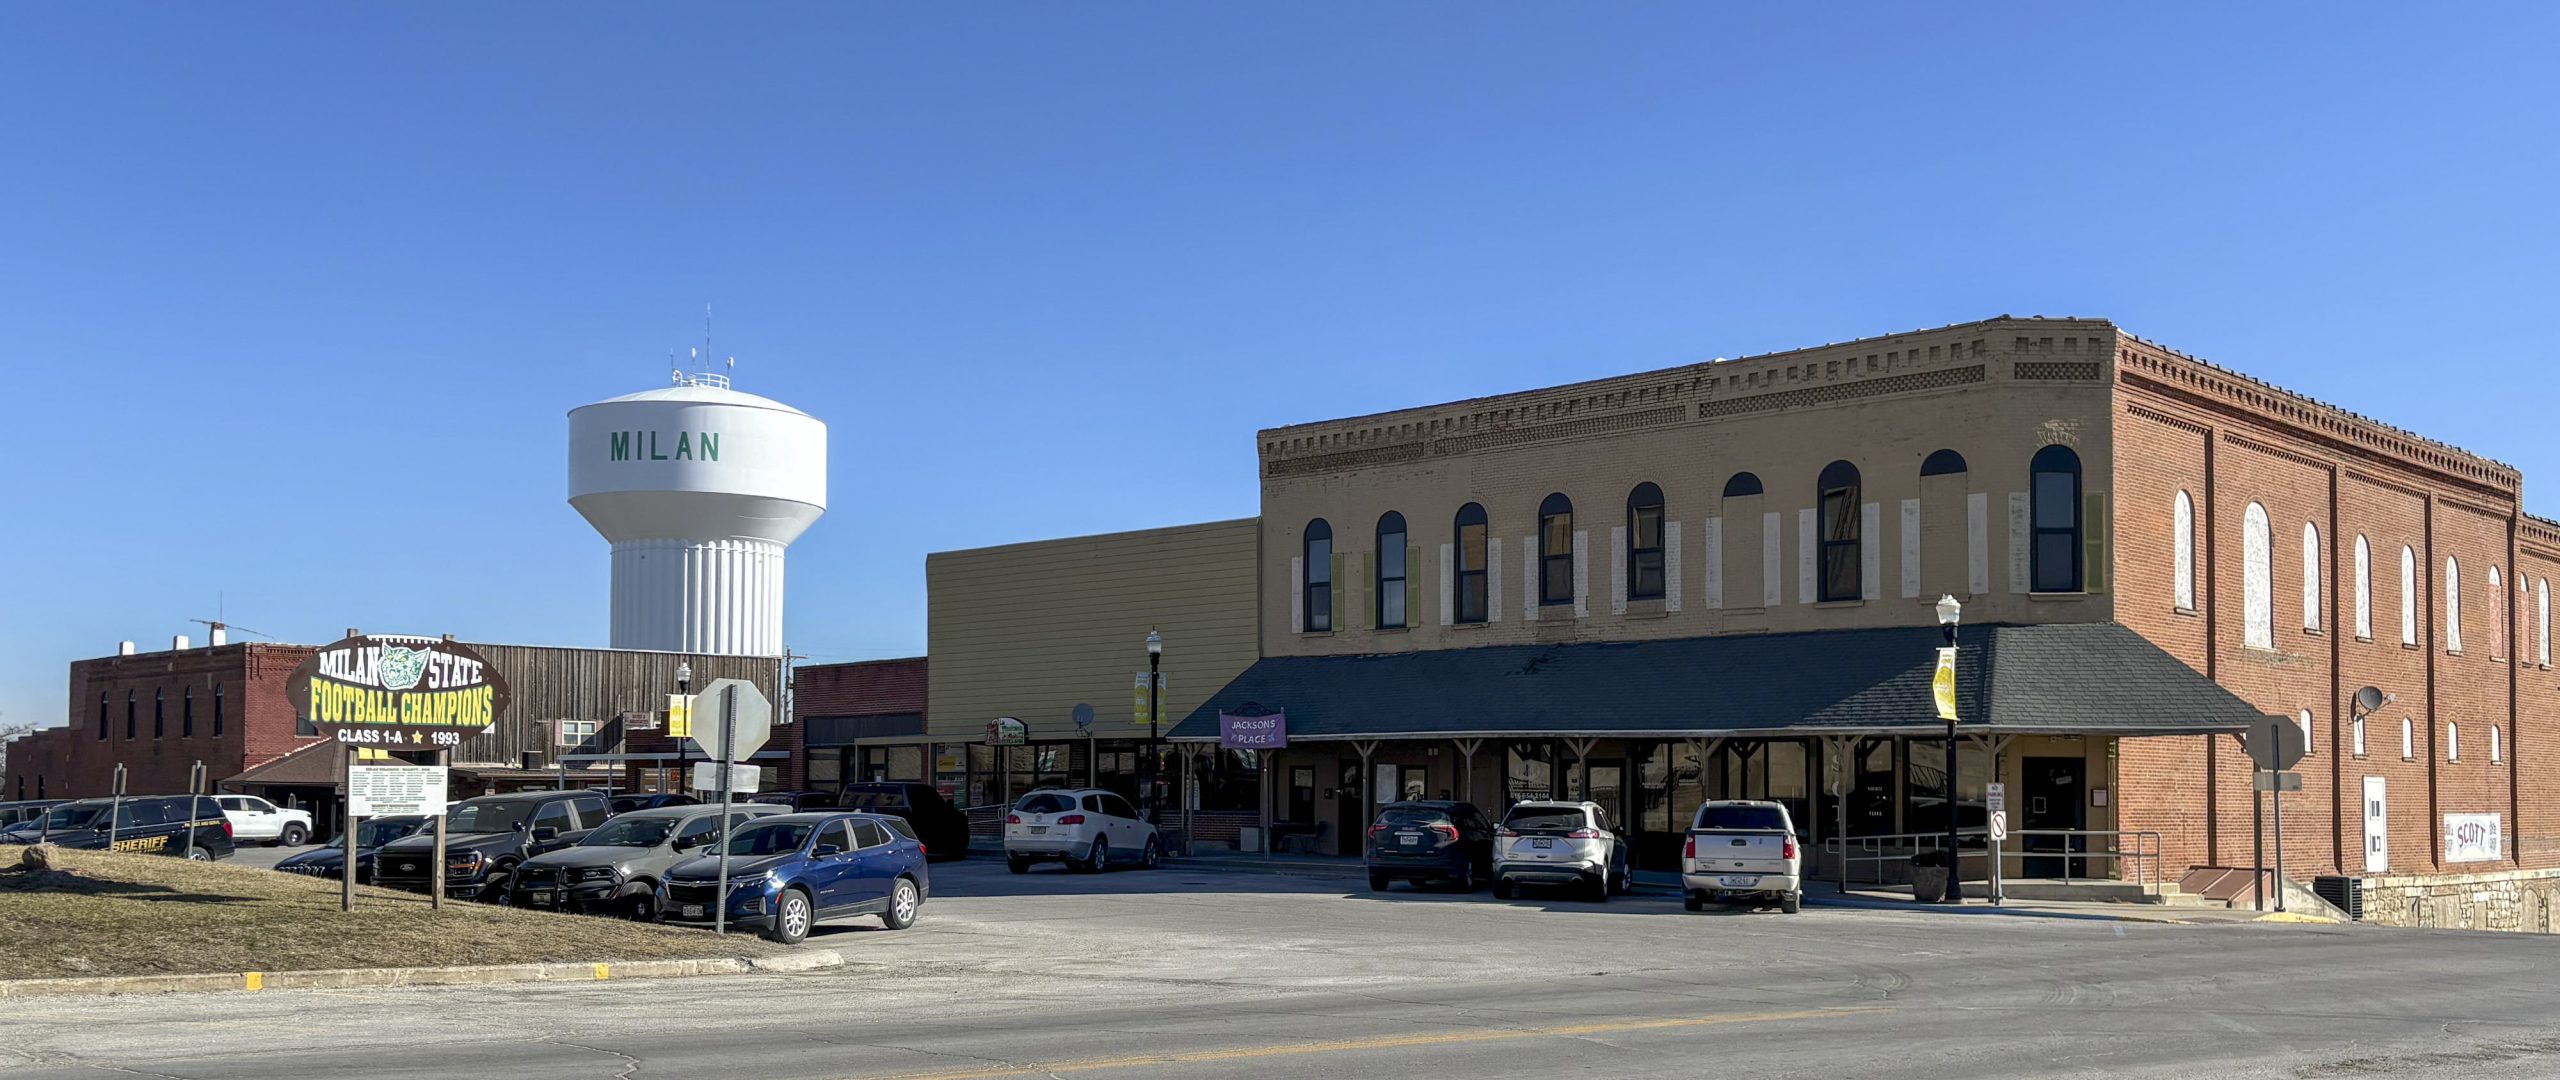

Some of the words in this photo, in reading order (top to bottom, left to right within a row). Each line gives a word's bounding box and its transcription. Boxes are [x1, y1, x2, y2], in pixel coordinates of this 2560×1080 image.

[610, 431, 720, 462] MILAN
[319, 647, 380, 687] MILAN
[428, 649, 483, 689] STATE
[310, 676, 398, 723] FOOTBALL
[400, 684, 494, 726] CHAMPIONS
[1231, 719, 1276, 730] JACKSONS
[338, 728, 380, 743] CLASS
[383, 729, 403, 743] 1-A
[431, 731, 460, 745] 1993
[1238, 734, 1266, 744] PLACE
[112, 835, 169, 852] SHERIFF
[2457, 822, 2486, 848] SCOTT
